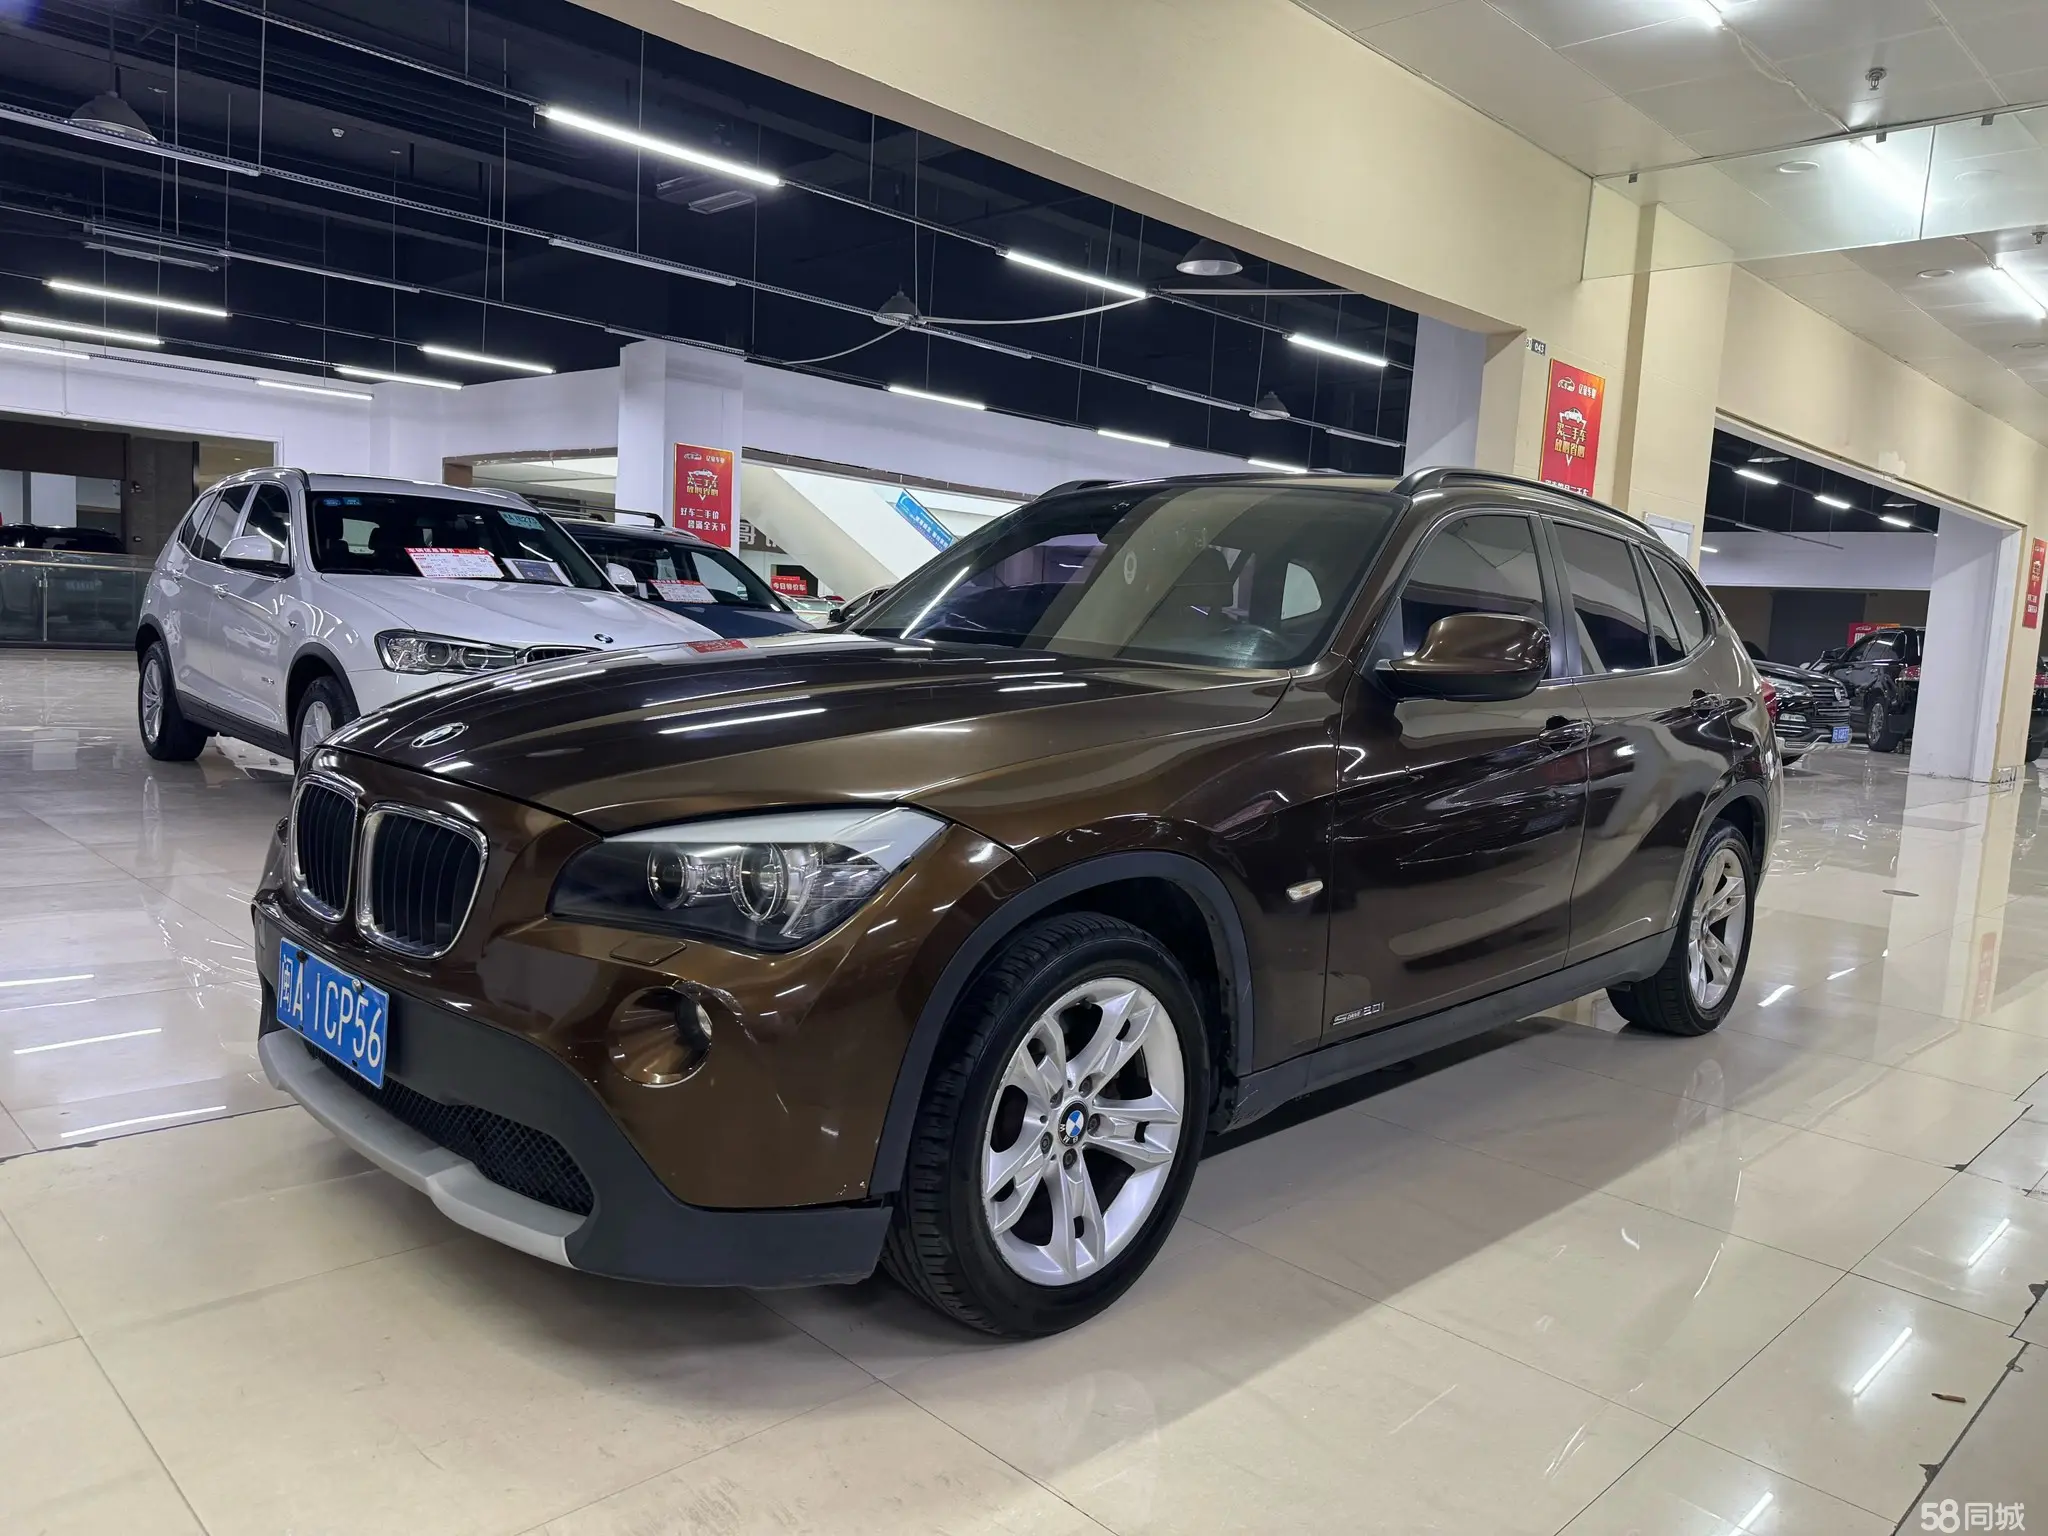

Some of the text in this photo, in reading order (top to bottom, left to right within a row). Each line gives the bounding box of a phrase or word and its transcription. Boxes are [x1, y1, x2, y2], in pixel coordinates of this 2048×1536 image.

[1556, 421, 1587, 442] 买二手车
[680, 507, 720, 520] 好车二手价
